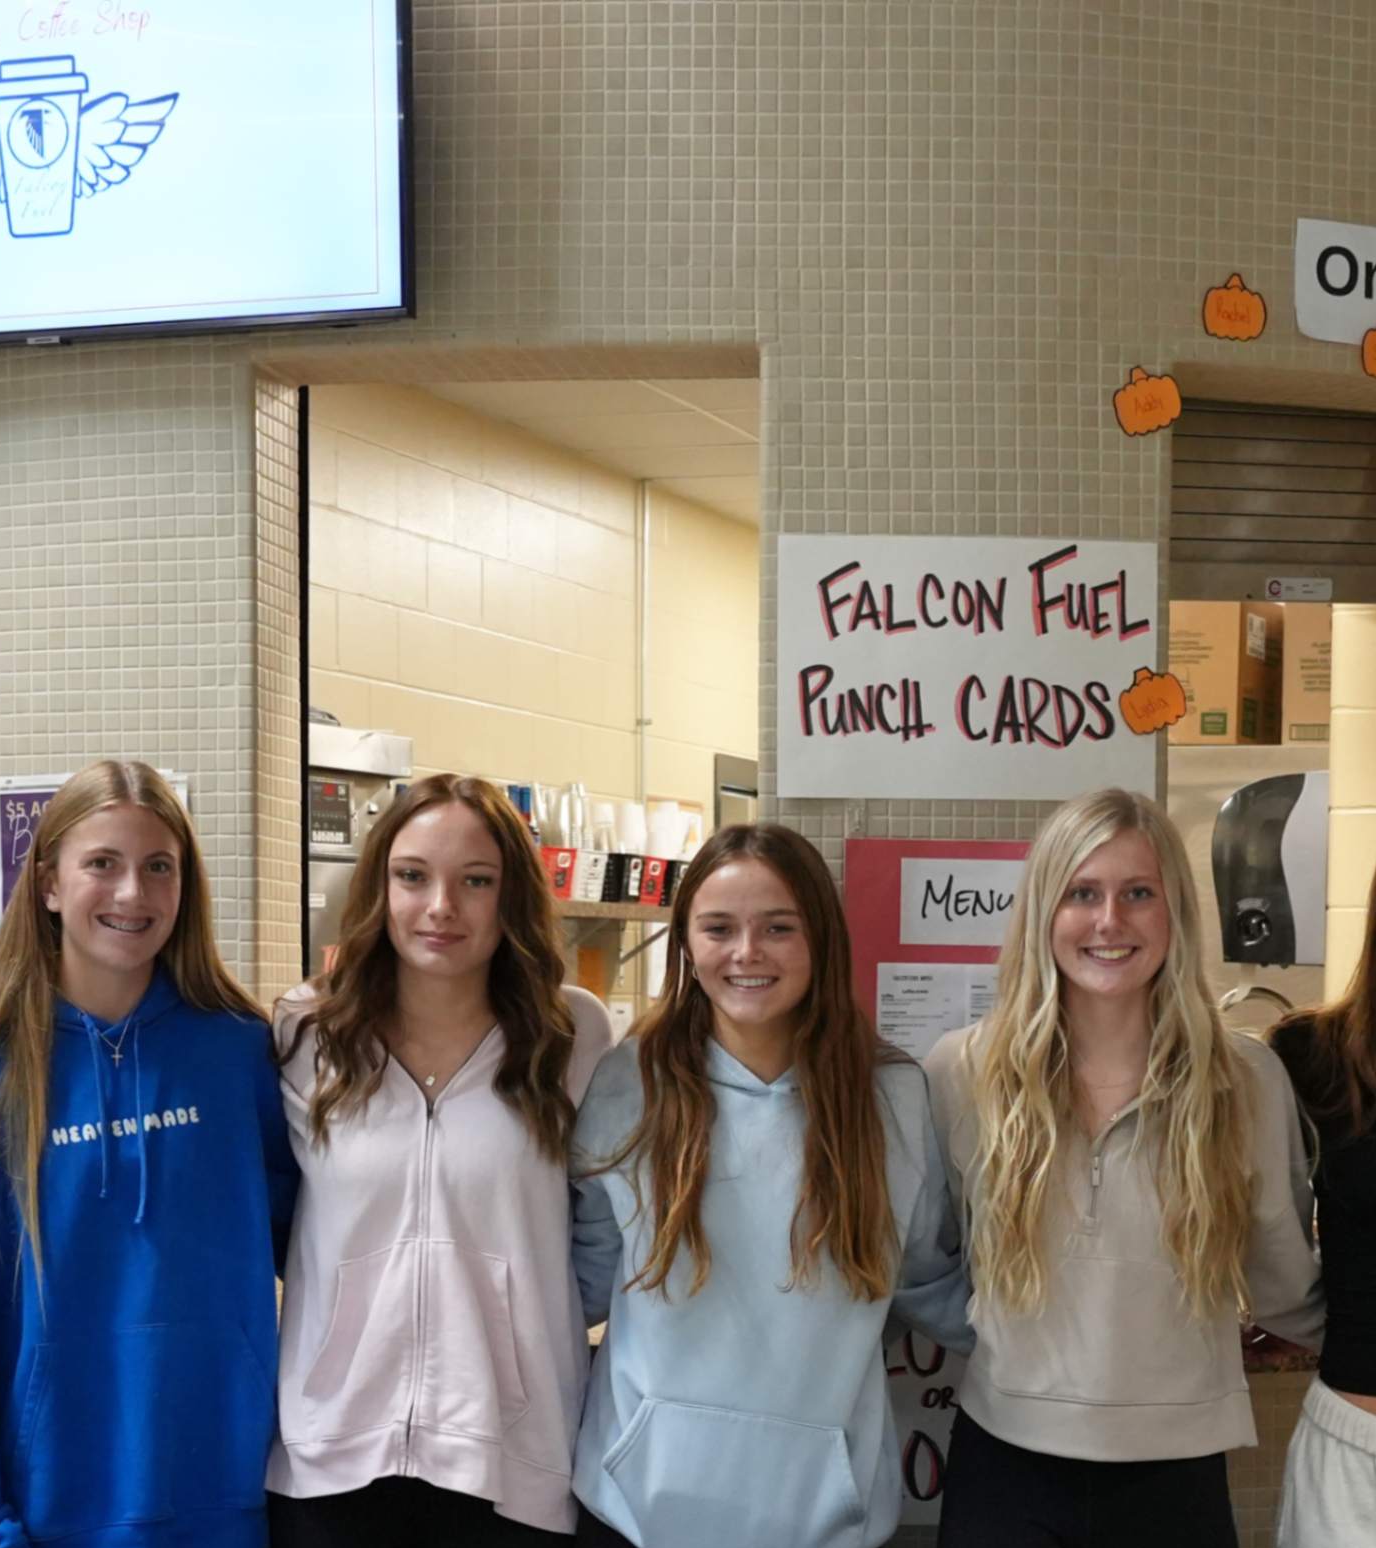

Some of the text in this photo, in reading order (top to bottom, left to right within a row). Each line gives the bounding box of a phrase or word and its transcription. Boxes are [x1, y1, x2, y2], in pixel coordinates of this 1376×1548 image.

[18, 1, 80, 42] Coffee
[93, 0, 151, 41] Shop
[817, 560, 1008, 641] FALCON
[1028, 544, 1150, 641] FUEL
[797, 663, 1116, 749] PUNCH CARDS
[5, 800, 26, 818] $5
[921, 873, 1015, 922] MENU
[143, 1106, 200, 1132] MADE
